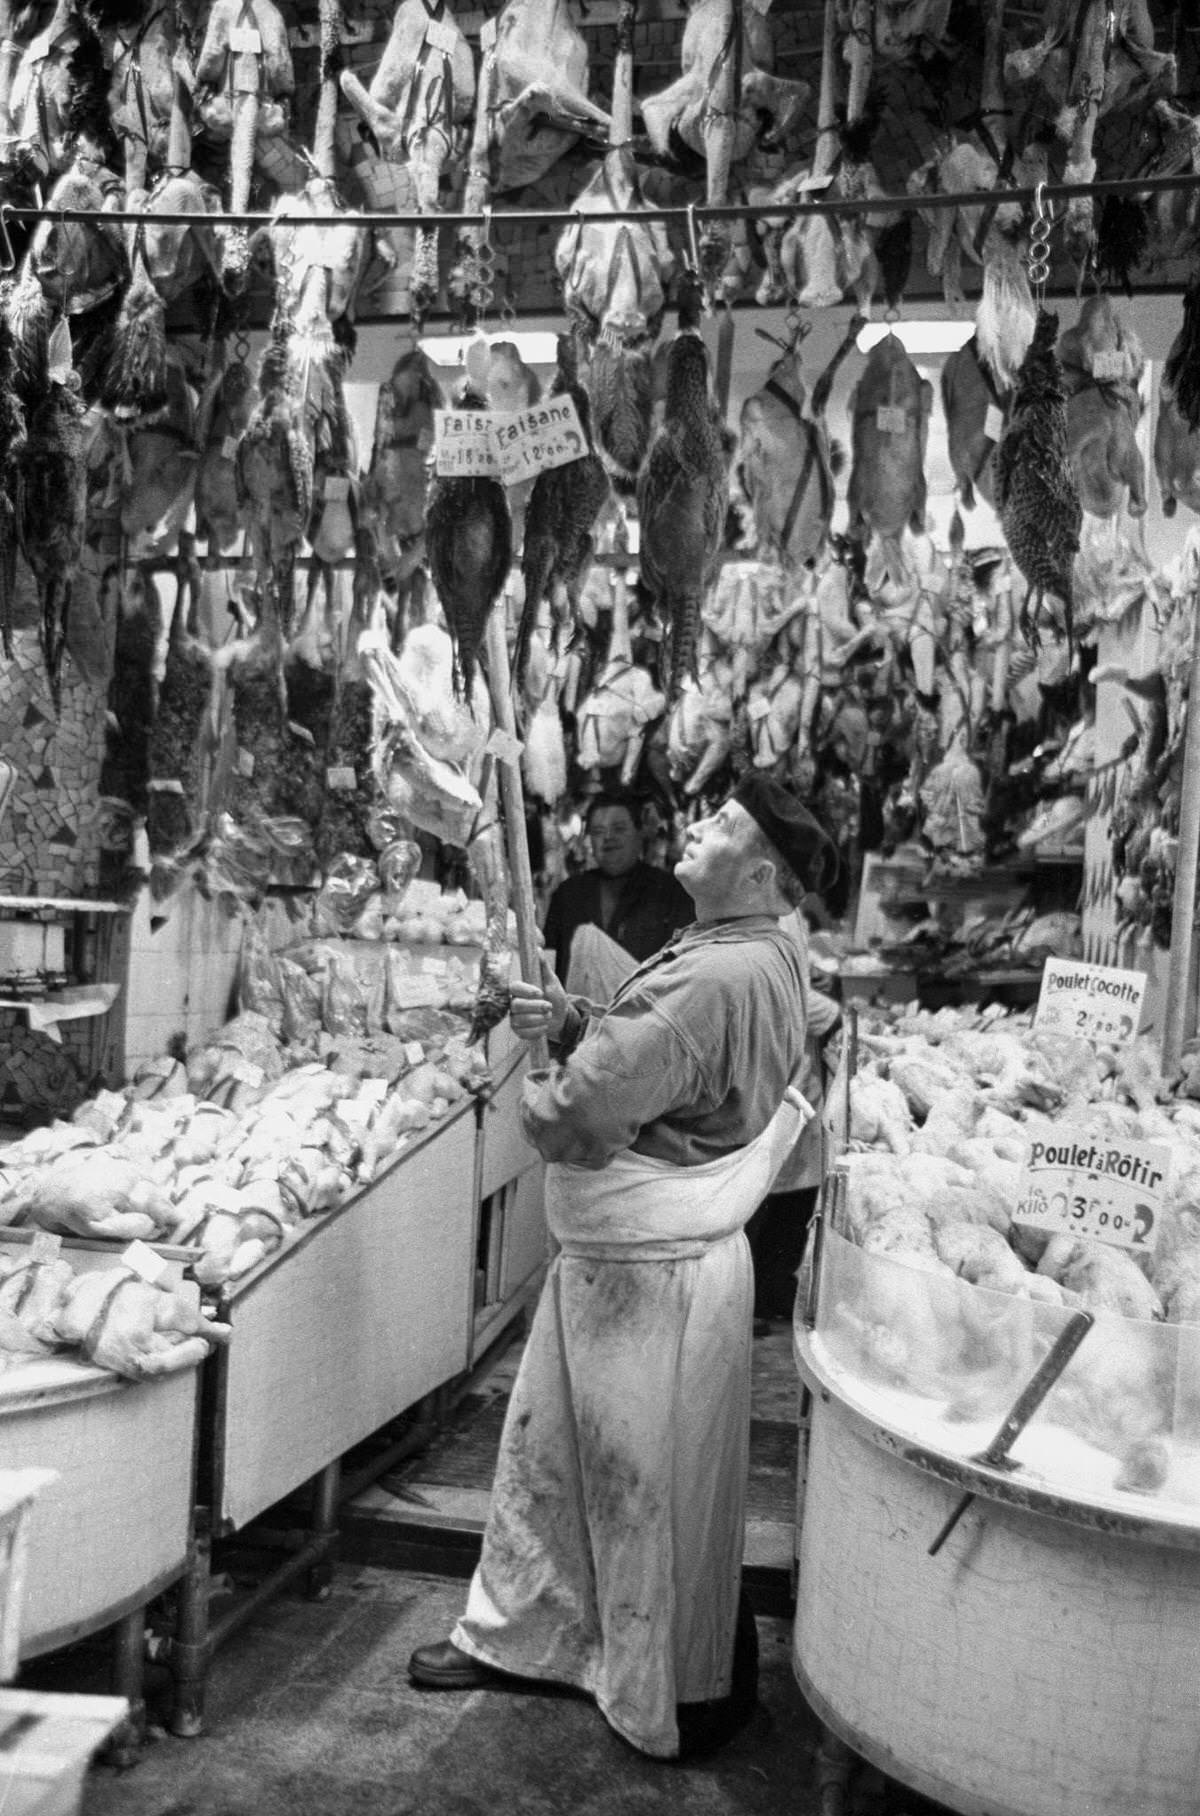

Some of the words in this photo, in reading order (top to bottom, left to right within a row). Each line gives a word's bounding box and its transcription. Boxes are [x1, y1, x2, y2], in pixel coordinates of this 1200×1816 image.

[496, 406, 570, 450] Faisane
[1047, 972, 1090, 990] Poulet
[1090, 976, 1140, 1004] Cocotte
[1027, 1142, 1098, 1169] Poulet
[1096, 1153, 1104, 1171] à
[1105, 1150, 1163, 1188] Rôtir
